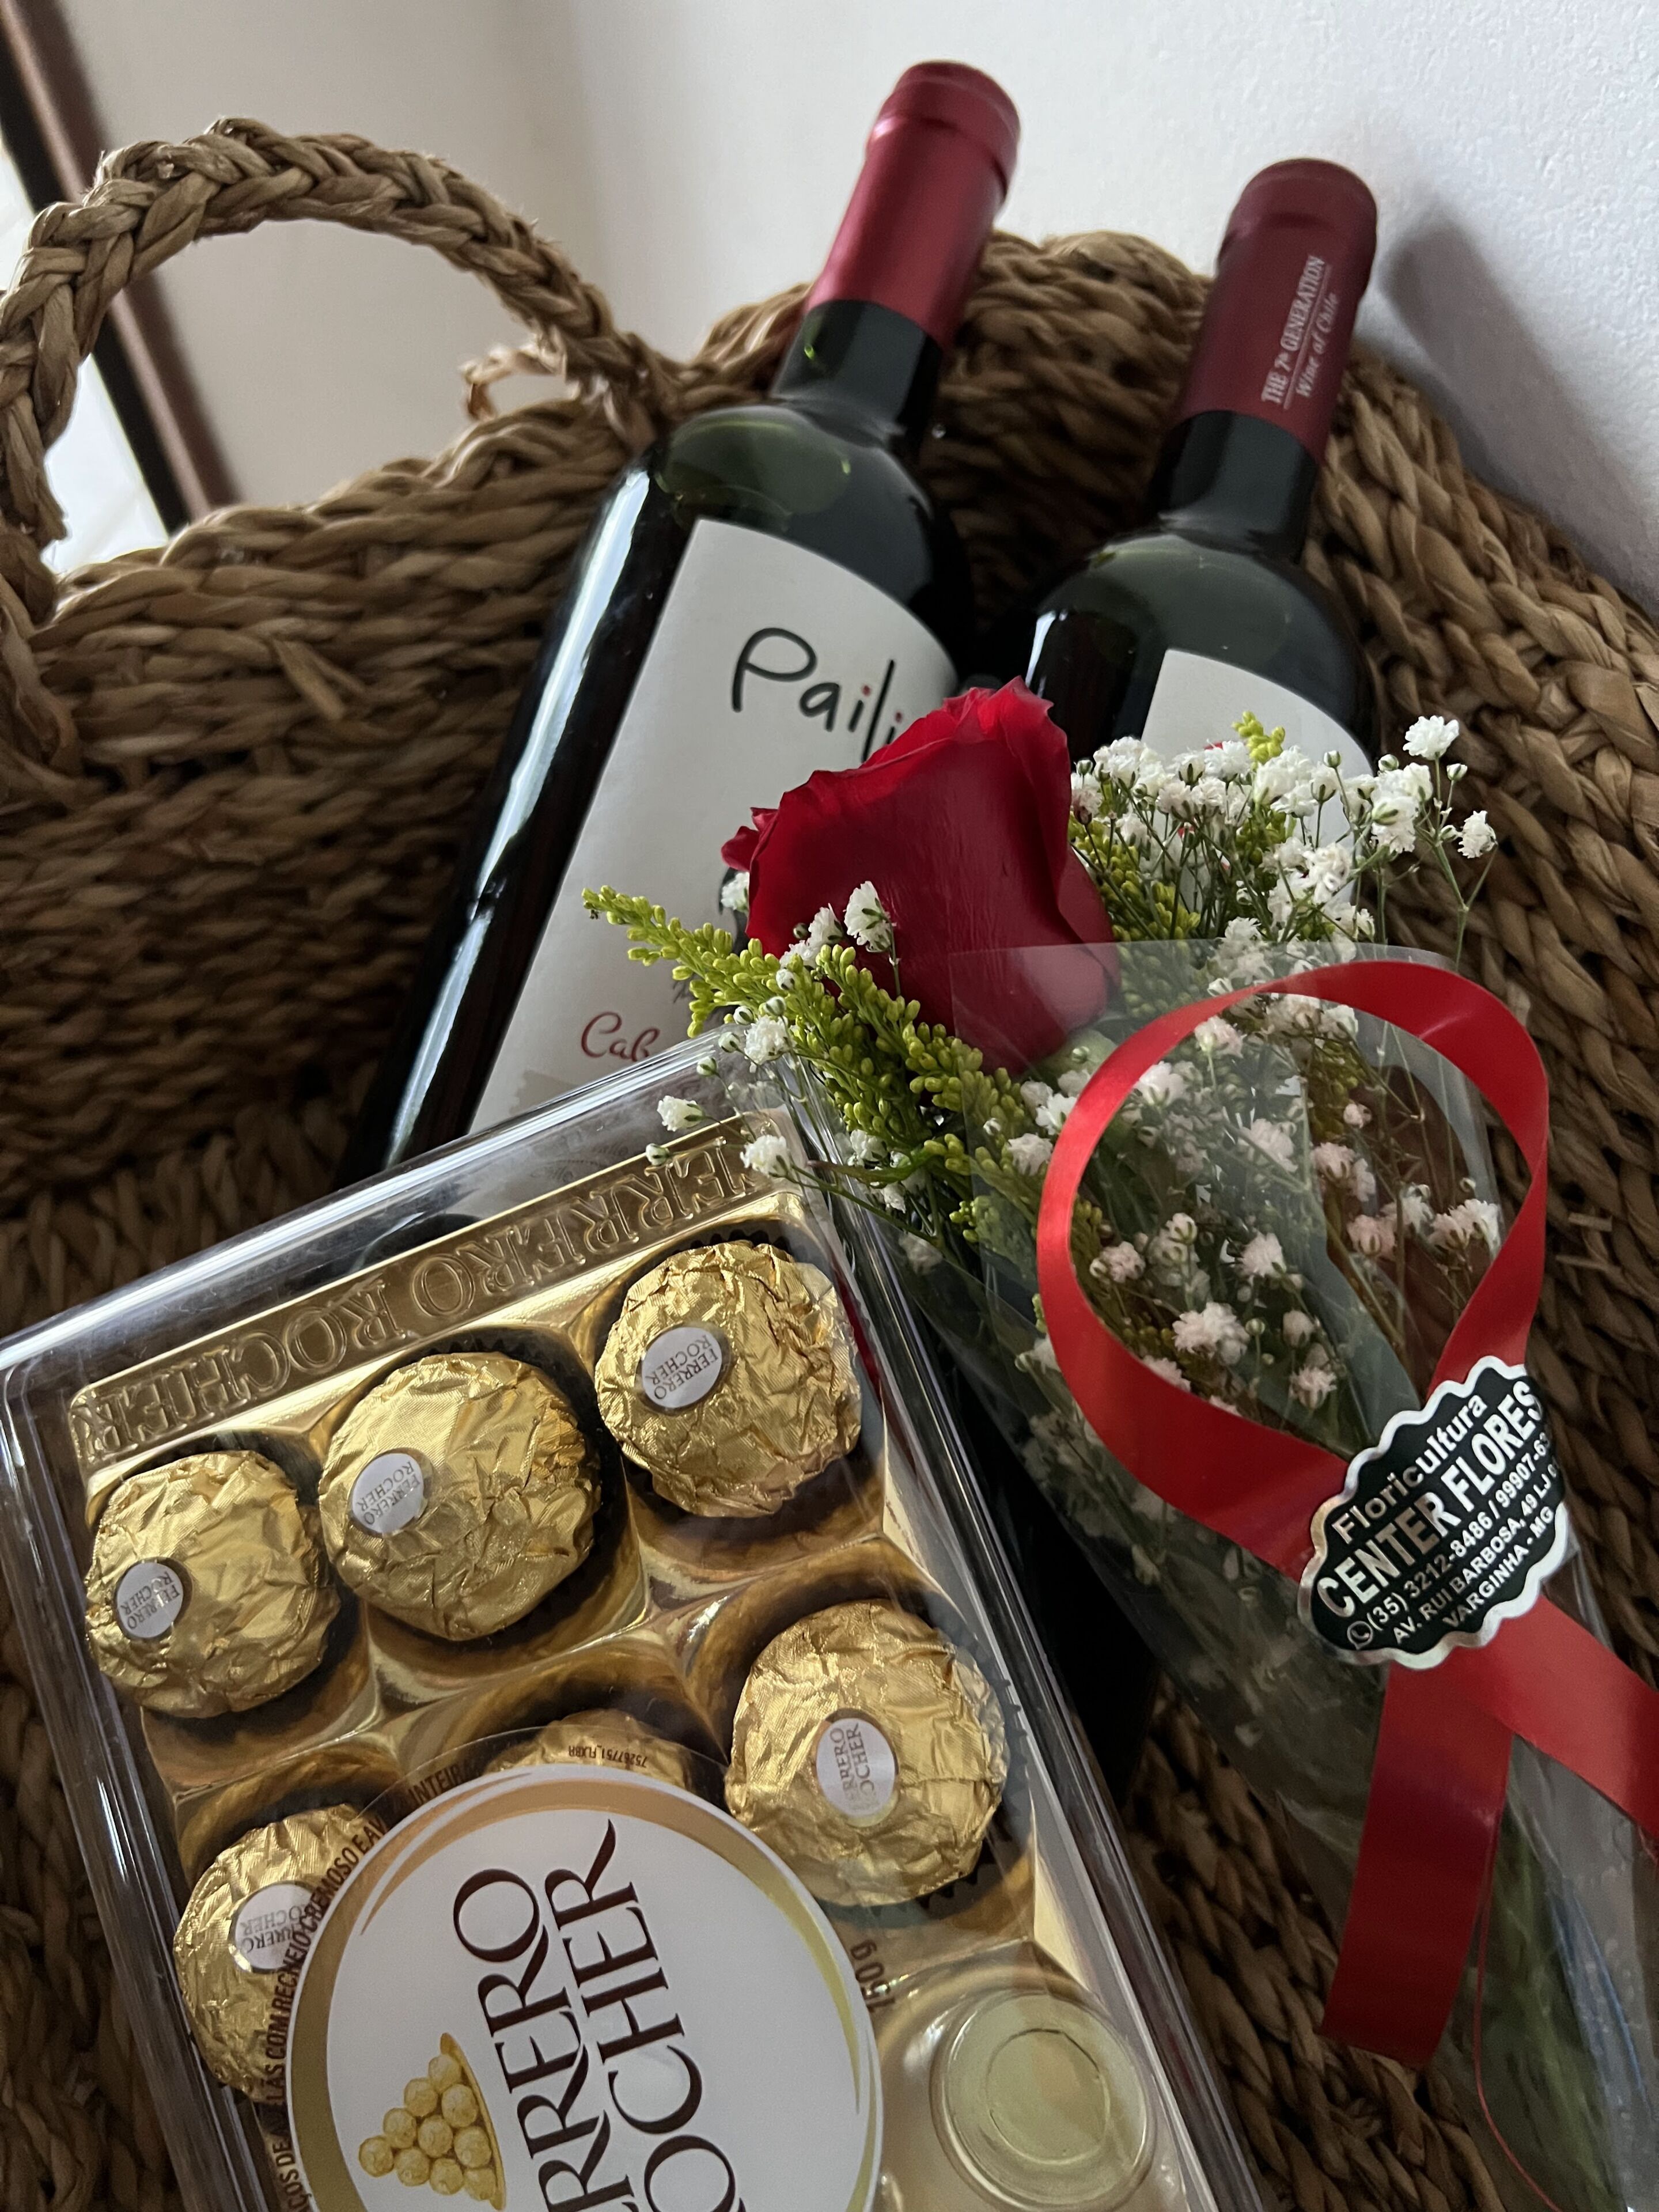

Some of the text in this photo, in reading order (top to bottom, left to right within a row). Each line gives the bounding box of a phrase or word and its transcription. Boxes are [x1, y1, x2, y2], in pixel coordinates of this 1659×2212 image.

[1262, 372, 1289, 403] THE
[1279, 255, 1325, 351] GENERATION
[1296, 292, 1339, 397] Wine of Chile
[70, 1279, 406, 1462] ROCHER
[645, 1334, 711, 1385] ROCHER
[654, 1348, 718, 1400] FERRERO
[355, 1461, 414, 1512] ROCHER
[363, 1474, 421, 1525] FERRERO
[1317, 1381, 1543, 1618] CENTER FLORES
[1331, 1395, 1487, 1544] Floricultura
[120, 1571, 173, 1615] ROCHER
[1367, 1592, 1410, 1631] (35)
[1404, 1512, 1493, 1598] 3212-8486
[1393, 1616, 1422, 1644] AV.
[1418, 1588, 1452, 1621] RUI
[1449, 1517, 1527, 1594] BARBOSA,
[1521, 1493, 1538, 1516] 49
[1533, 1473, 1551, 1499] LJ
[1442, 1544, 1529, 1627] VARGINHA
[1529, 1506, 1554, 1539] MG
[830, 1728, 860, 1804] ERRERO
[846, 1722, 876, 1798] OCHER
[352, 1834, 368, 1854] E
[240, 1904, 306, 1936] OCHER
[299, 1847, 359, 1933] CREMOSO
[271, 1930, 312, 2013] RECHEIO
[266, 2014, 289, 2060] COM
[453, 1868, 641, 2212] RRERO
[544, 1819, 747, 2212] OCHER
[272, 2142, 296, 2167] DE
